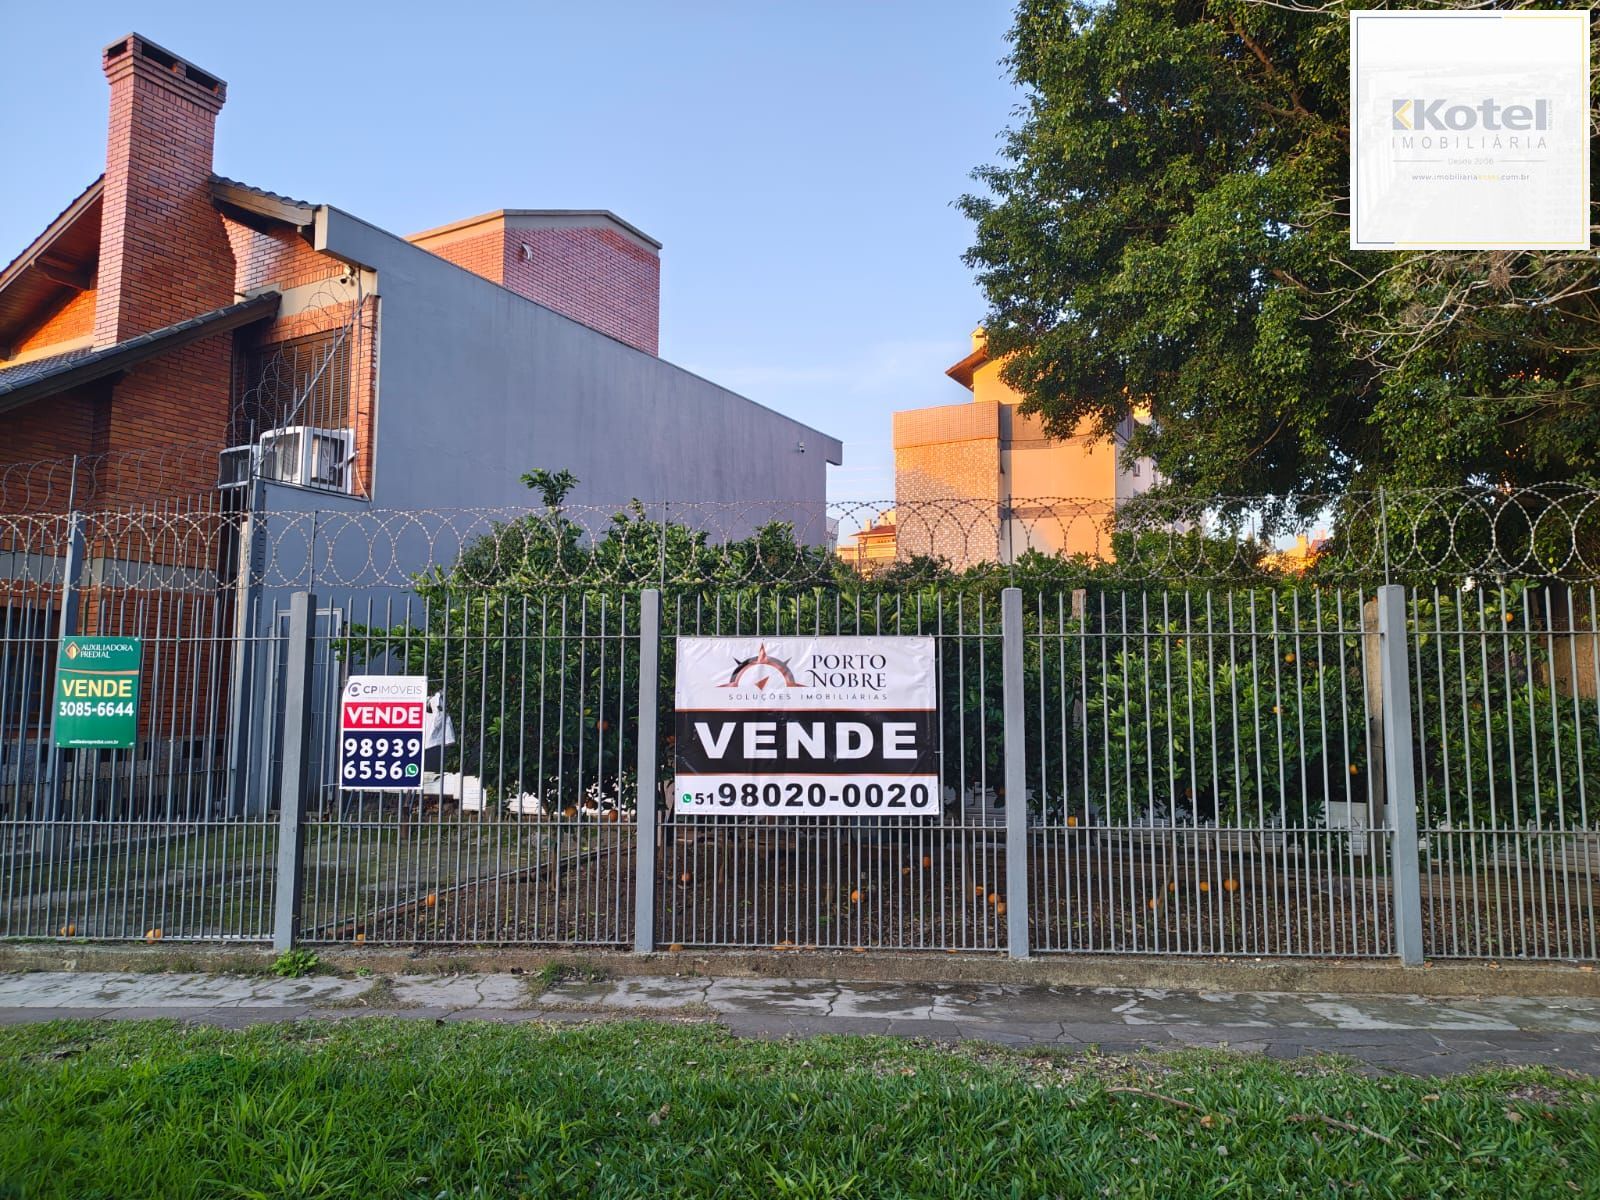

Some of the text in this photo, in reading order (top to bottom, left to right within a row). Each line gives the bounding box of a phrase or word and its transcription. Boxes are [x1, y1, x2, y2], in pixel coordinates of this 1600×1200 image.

[80, 643, 134, 652] AUXILIADORA
[80, 650, 111, 659] PREDIAL
[812, 654, 887, 670] PORTO
[62, 680, 133, 697] VENDE
[806, 669, 887, 691] NOBRE
[728, 692, 888, 702] SOLUÇÕES IMOBILIÁRIAS
[59, 701, 135, 717] 3085-6644
[346, 706, 422, 725] VENDE
[344, 738, 421, 758] 98939
[694, 721, 918, 760] VENDE
[343, 760, 403, 780] 6556
[717, 782, 930, 808] 98020-0020
